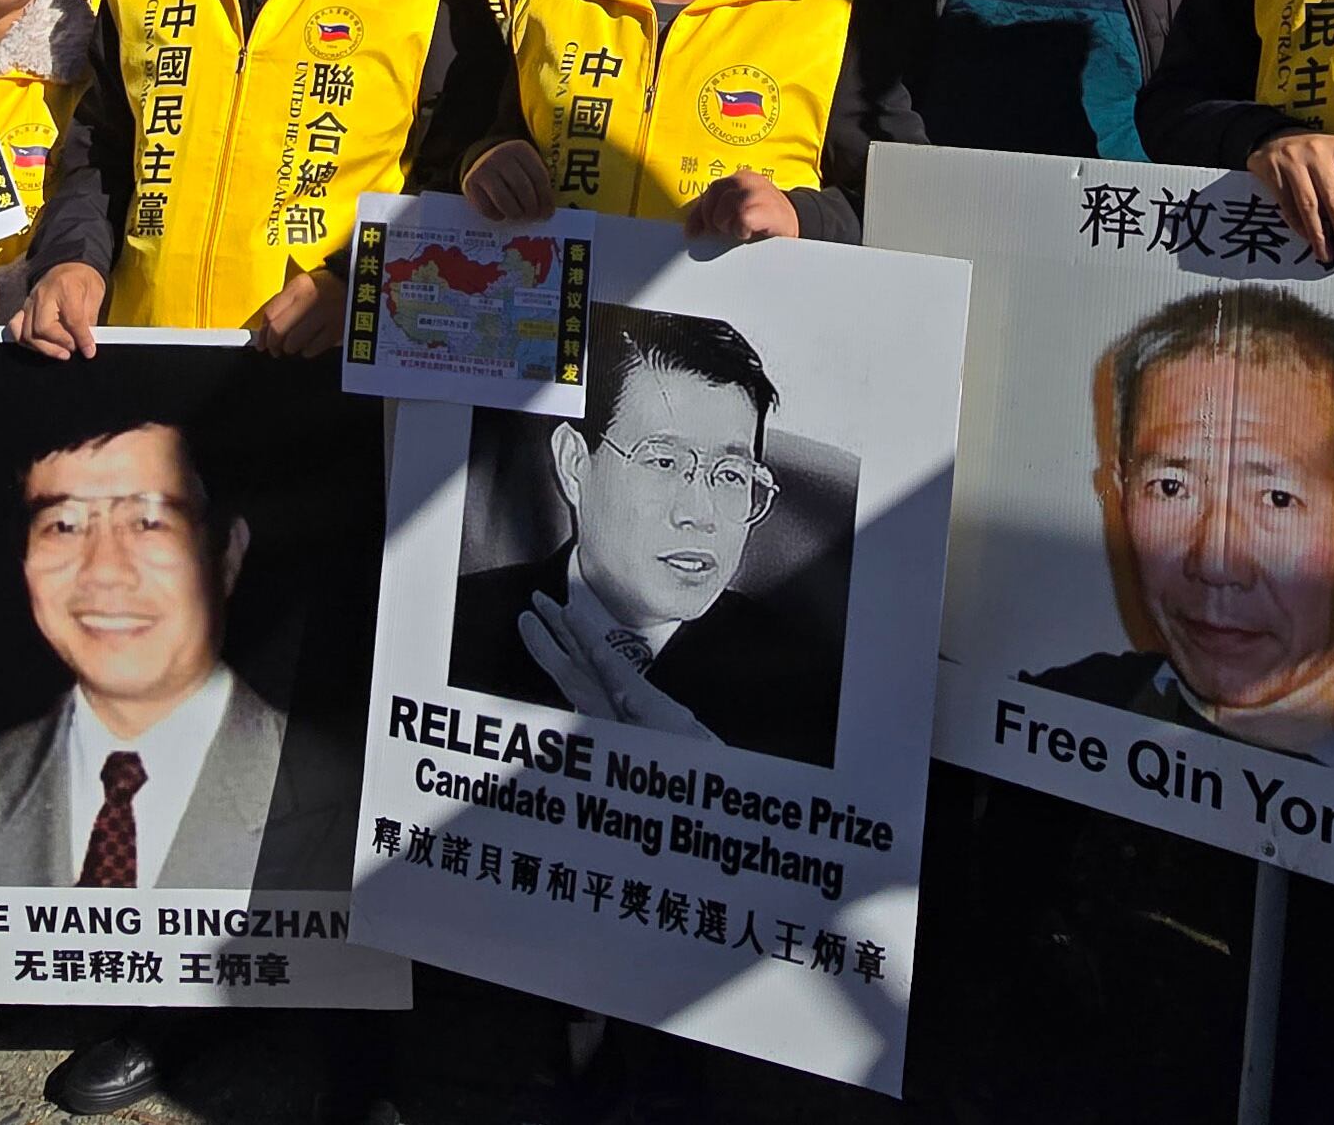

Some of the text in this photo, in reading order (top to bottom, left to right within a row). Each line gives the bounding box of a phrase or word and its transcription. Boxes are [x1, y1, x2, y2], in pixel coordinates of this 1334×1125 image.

[289, 61, 309, 118] UNITED
[556, 41, 579, 98] CHINA
[700, 94, 777, 144] CHINA DEMOCRACY PARTY
[284, 62, 355, 245] 聯合總部
[559, 46, 624, 209] 中國民
[388, 695, 894, 852] RELEASE Nobel Peace Prize
[993, 698, 1108, 774] Free
[1127, 738, 1223, 811] Qin
[415, 757, 845, 902] Candidate Wang Bingzhang
[24, 905, 142, 937] WANG
[157, 907, 351, 940] BINGZHAN
[370, 815, 887, 986] 釋放諾貝爾和平獎候選人王炳章
[13, 949, 292, 987] 无罪释放 王炳章
